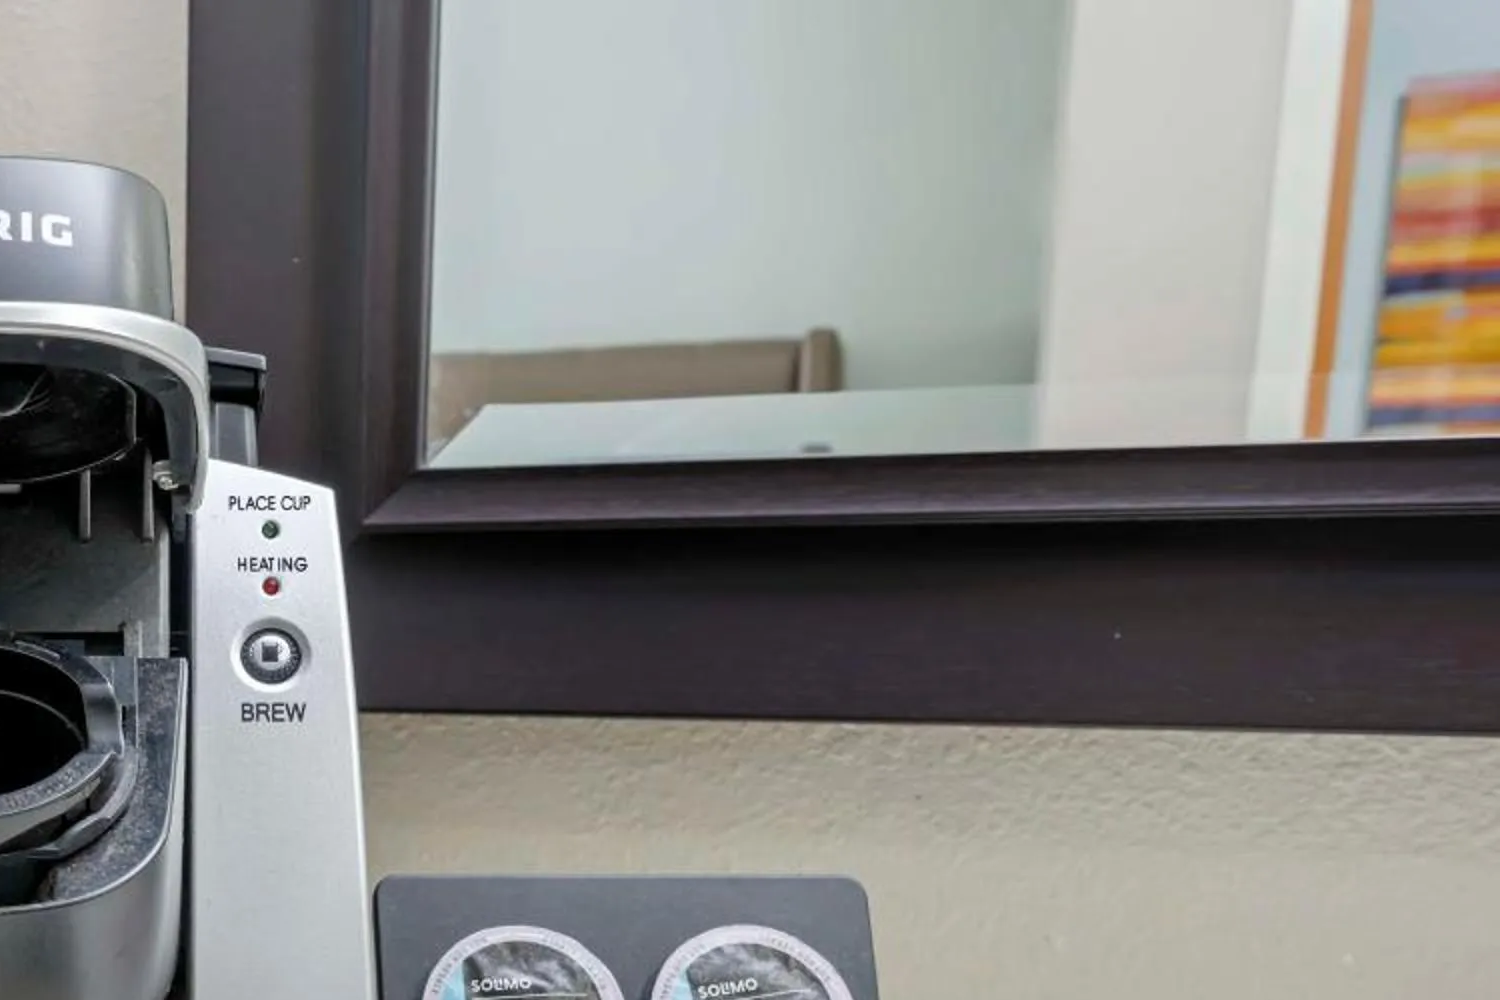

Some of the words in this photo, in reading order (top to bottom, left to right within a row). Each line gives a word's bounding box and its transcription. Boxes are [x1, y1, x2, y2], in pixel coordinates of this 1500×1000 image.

[227, 495, 277, 511] PLACE
[280, 495, 312, 511] CUP
[237, 556, 309, 572] HEATING
[240, 703, 307, 723] BREW
